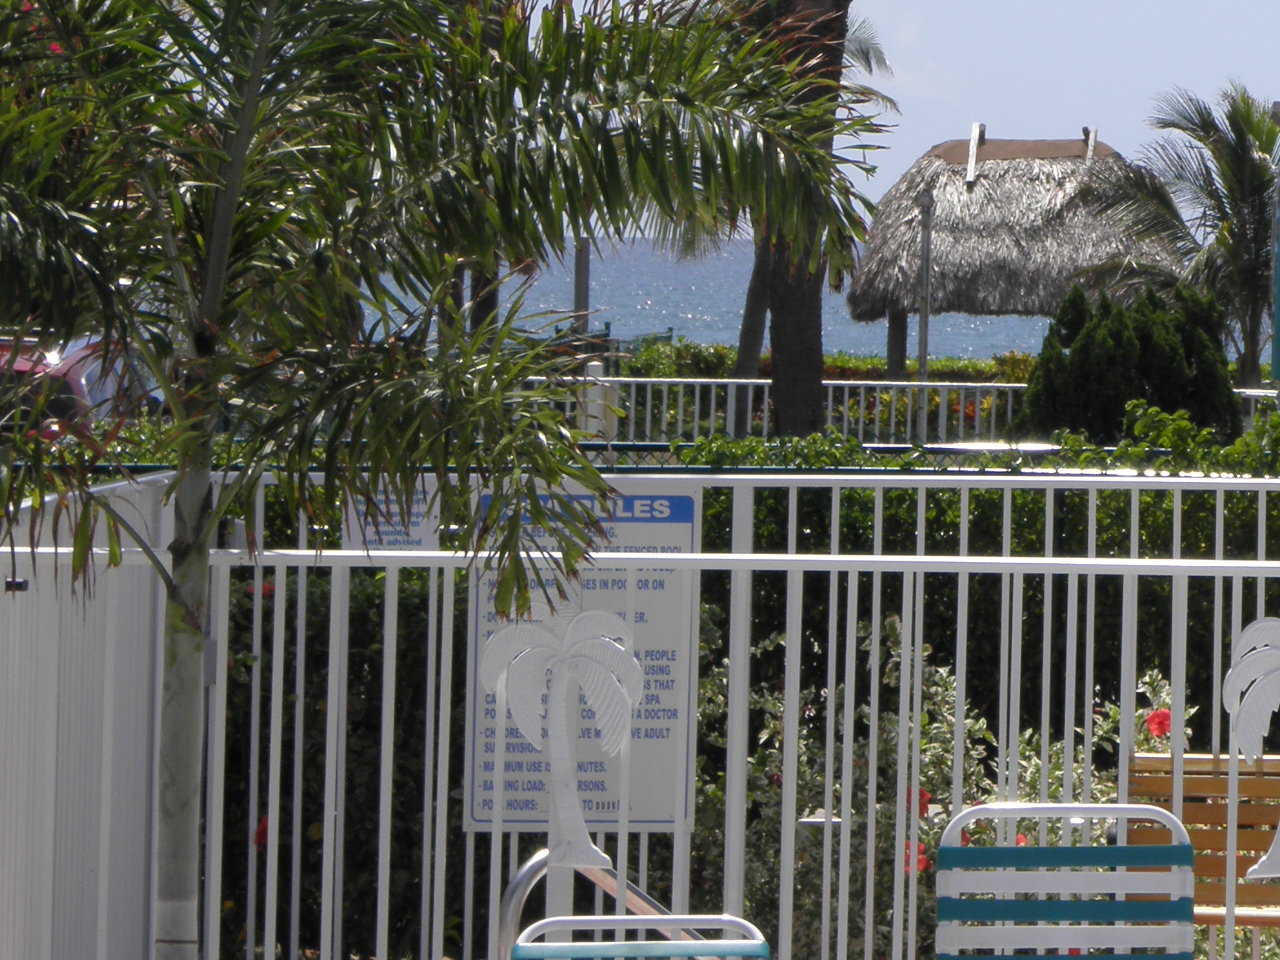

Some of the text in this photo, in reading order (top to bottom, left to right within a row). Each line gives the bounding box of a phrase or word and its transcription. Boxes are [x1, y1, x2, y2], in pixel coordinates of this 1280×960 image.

[637, 579, 650, 590] OR
[652, 579, 665, 590] ON
[644, 650, 677, 661] PEOPLE
[644, 665, 671, 676] USING
[654, 680, 675, 690] THAT
[645, 694, 661, 705] SPA
[484, 708, 513, 719] POS
[644, 709, 678, 720] DOCTOR
[484, 727, 526, 739] CHDRE
[643, 728, 671, 739] ADULT
[483, 761, 523, 772] MAMUM
[526, 761, 542, 772] USE
[577, 761, 606, 772] NUTES.
[483, 780, 519, 791] BAING
[577, 780, 607, 792] RSONS.
[506, 799, 538, 811] HOURS:
[582, 799, 593, 810] TO
